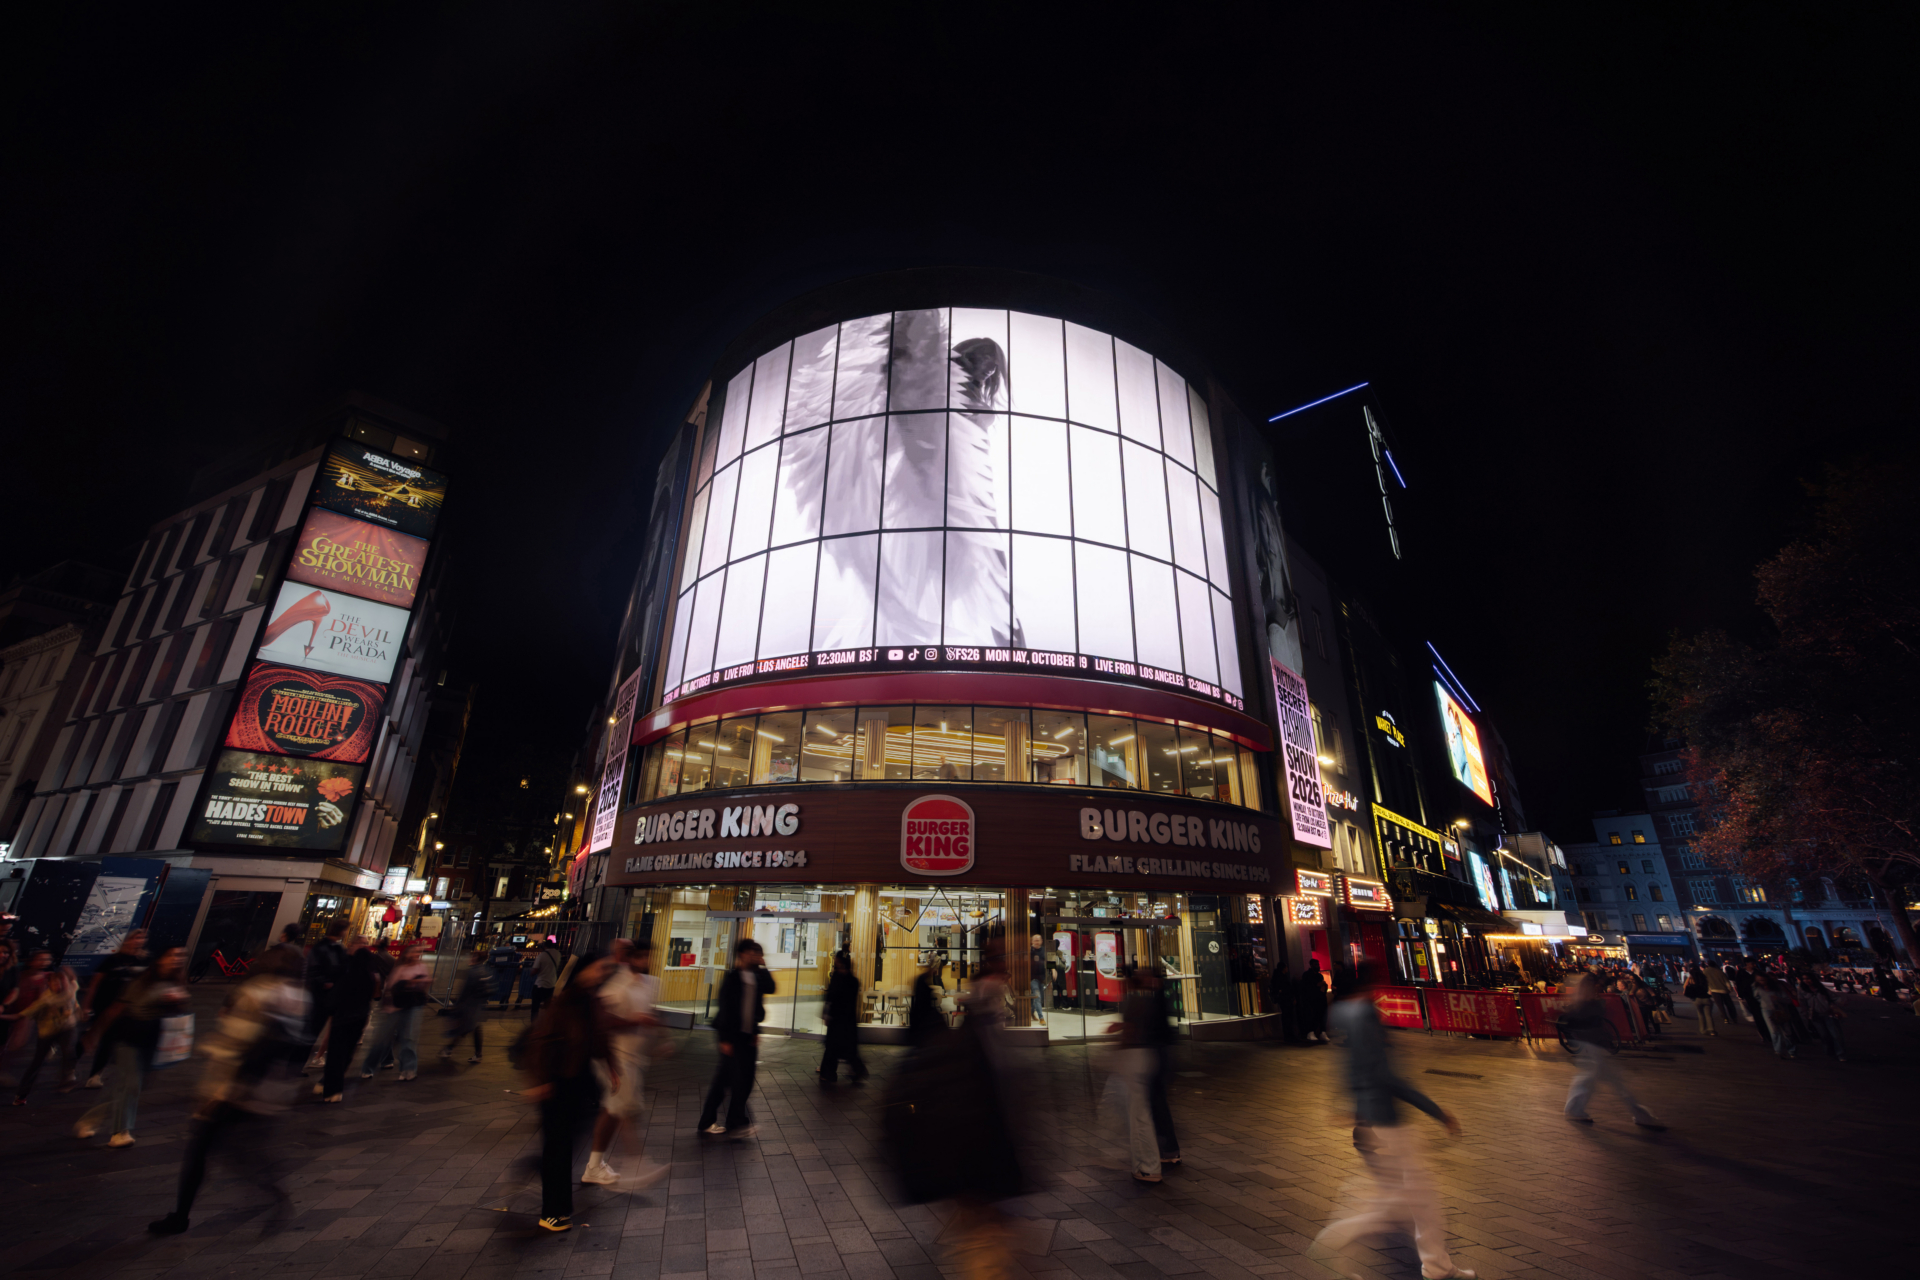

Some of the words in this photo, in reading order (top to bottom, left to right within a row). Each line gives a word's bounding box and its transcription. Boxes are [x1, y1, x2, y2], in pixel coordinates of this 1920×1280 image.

[363, 452, 390, 468] ABBA
[390, 460, 422, 479] Voyage
[311, 536, 414, 576] GREATEST
[354, 540, 380, 555] THE
[299, 548, 415, 591] SHOWMAN
[313, 567, 337, 579] THE
[342, 575, 396, 594] MUSICAL
[340, 613, 362, 624] THE
[328, 619, 392, 645] DEVIL
[344, 635, 379, 649] WEARS
[329, 635, 387, 661] PRADA
[350, 653, 377, 664] MUSICAL
[724, 666, 739, 681] LIVE
[759, 661, 774, 674] LOS
[816, 654, 855, 667] 12:30AM
[859, 648, 879, 663] BST
[1031, 651, 1077, 669] OCTOBER
[1095, 658, 1114, 673] LIVE
[1139, 665, 1154, 680] LOS
[1154, 669, 1185, 687] ANGELES
[271, 694, 341, 722] MOULIN
[1277, 684, 1308, 717] SECRET
[1285, 743, 1317, 780] SHOW
[228, 777, 258, 790] SHOW
[259, 780, 271, 791] IN
[269, 774, 294, 785] BEST
[1290, 771, 1322, 808] 2026
[1323, 781, 1344, 808] Pizza
[1343, 789, 1359, 812] Hut
[205, 800, 308, 825] HADESTOWN
[634, 808, 716, 845] BURGER
[720, 803, 800, 838] KING
[906, 820, 970, 836] BURGER
[1080, 807, 1207, 848] BURGER
[1208, 818, 1262, 854] KING
[905, 835, 970, 857] KING
[625, 857, 654, 873] FLAME
[654, 853, 713, 872] GRILLING
[714, 851, 763, 869] SINCE
[764, 850, 808, 868] 1954
[1069, 854, 1135, 874] FLAME
[1137, 857, 1211, 878] GRILLING
[1211, 862, 1249, 881] SINCE
[1249, 868, 1271, 883] 1954
[1295, 902, 1316, 912] Pizza
[1297, 910, 1314, 919] Hut
[1448, 992, 1476, 1012] EAT
[1484, 994, 1502, 1031] FRESH
[1452, 1011, 1480, 1030] HOT
